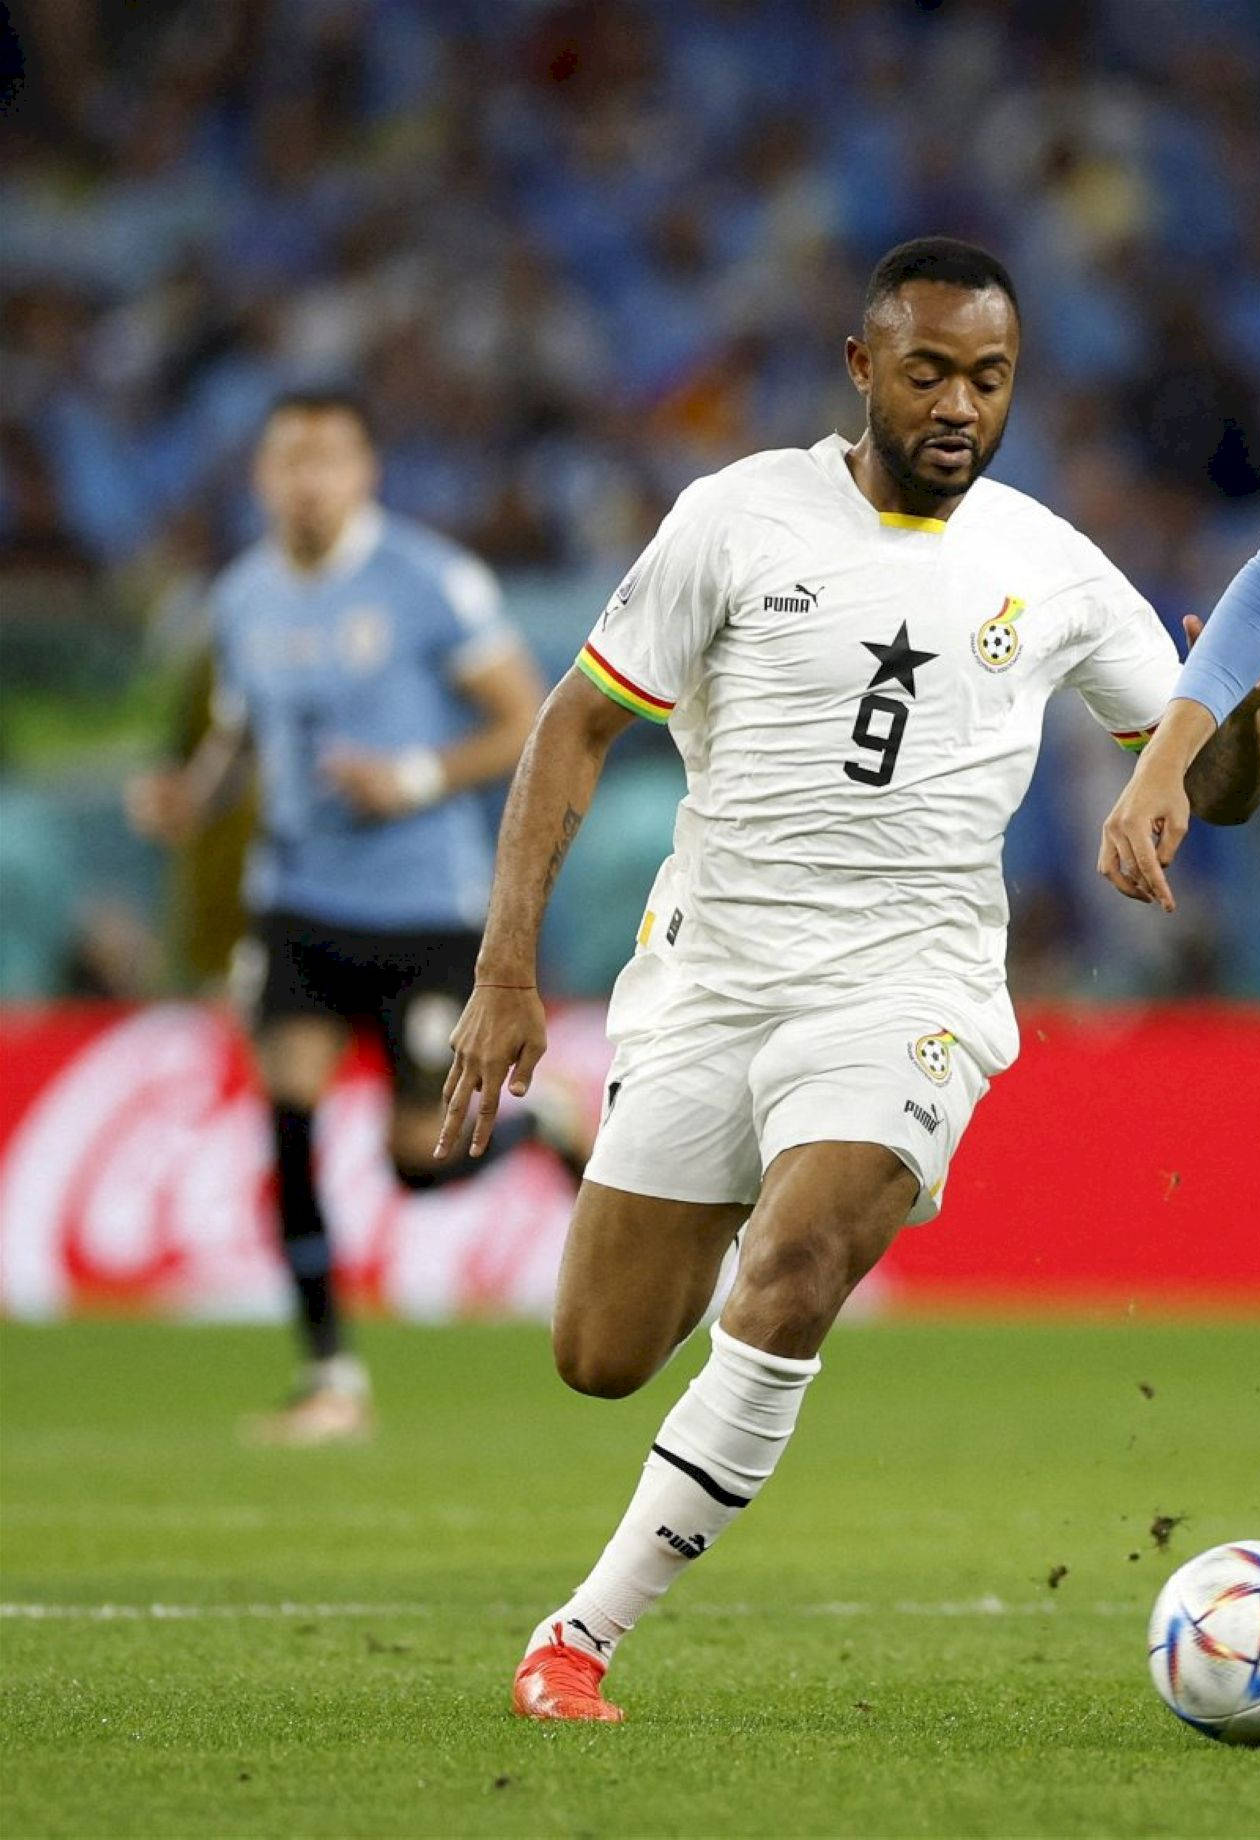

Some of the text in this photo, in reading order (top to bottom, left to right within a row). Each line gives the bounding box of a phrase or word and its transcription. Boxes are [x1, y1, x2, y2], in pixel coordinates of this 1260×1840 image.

[763, 595, 811, 614] PUMA
[843, 694, 910, 788] 9
[904, 1099, 938, 1136] PUMA
